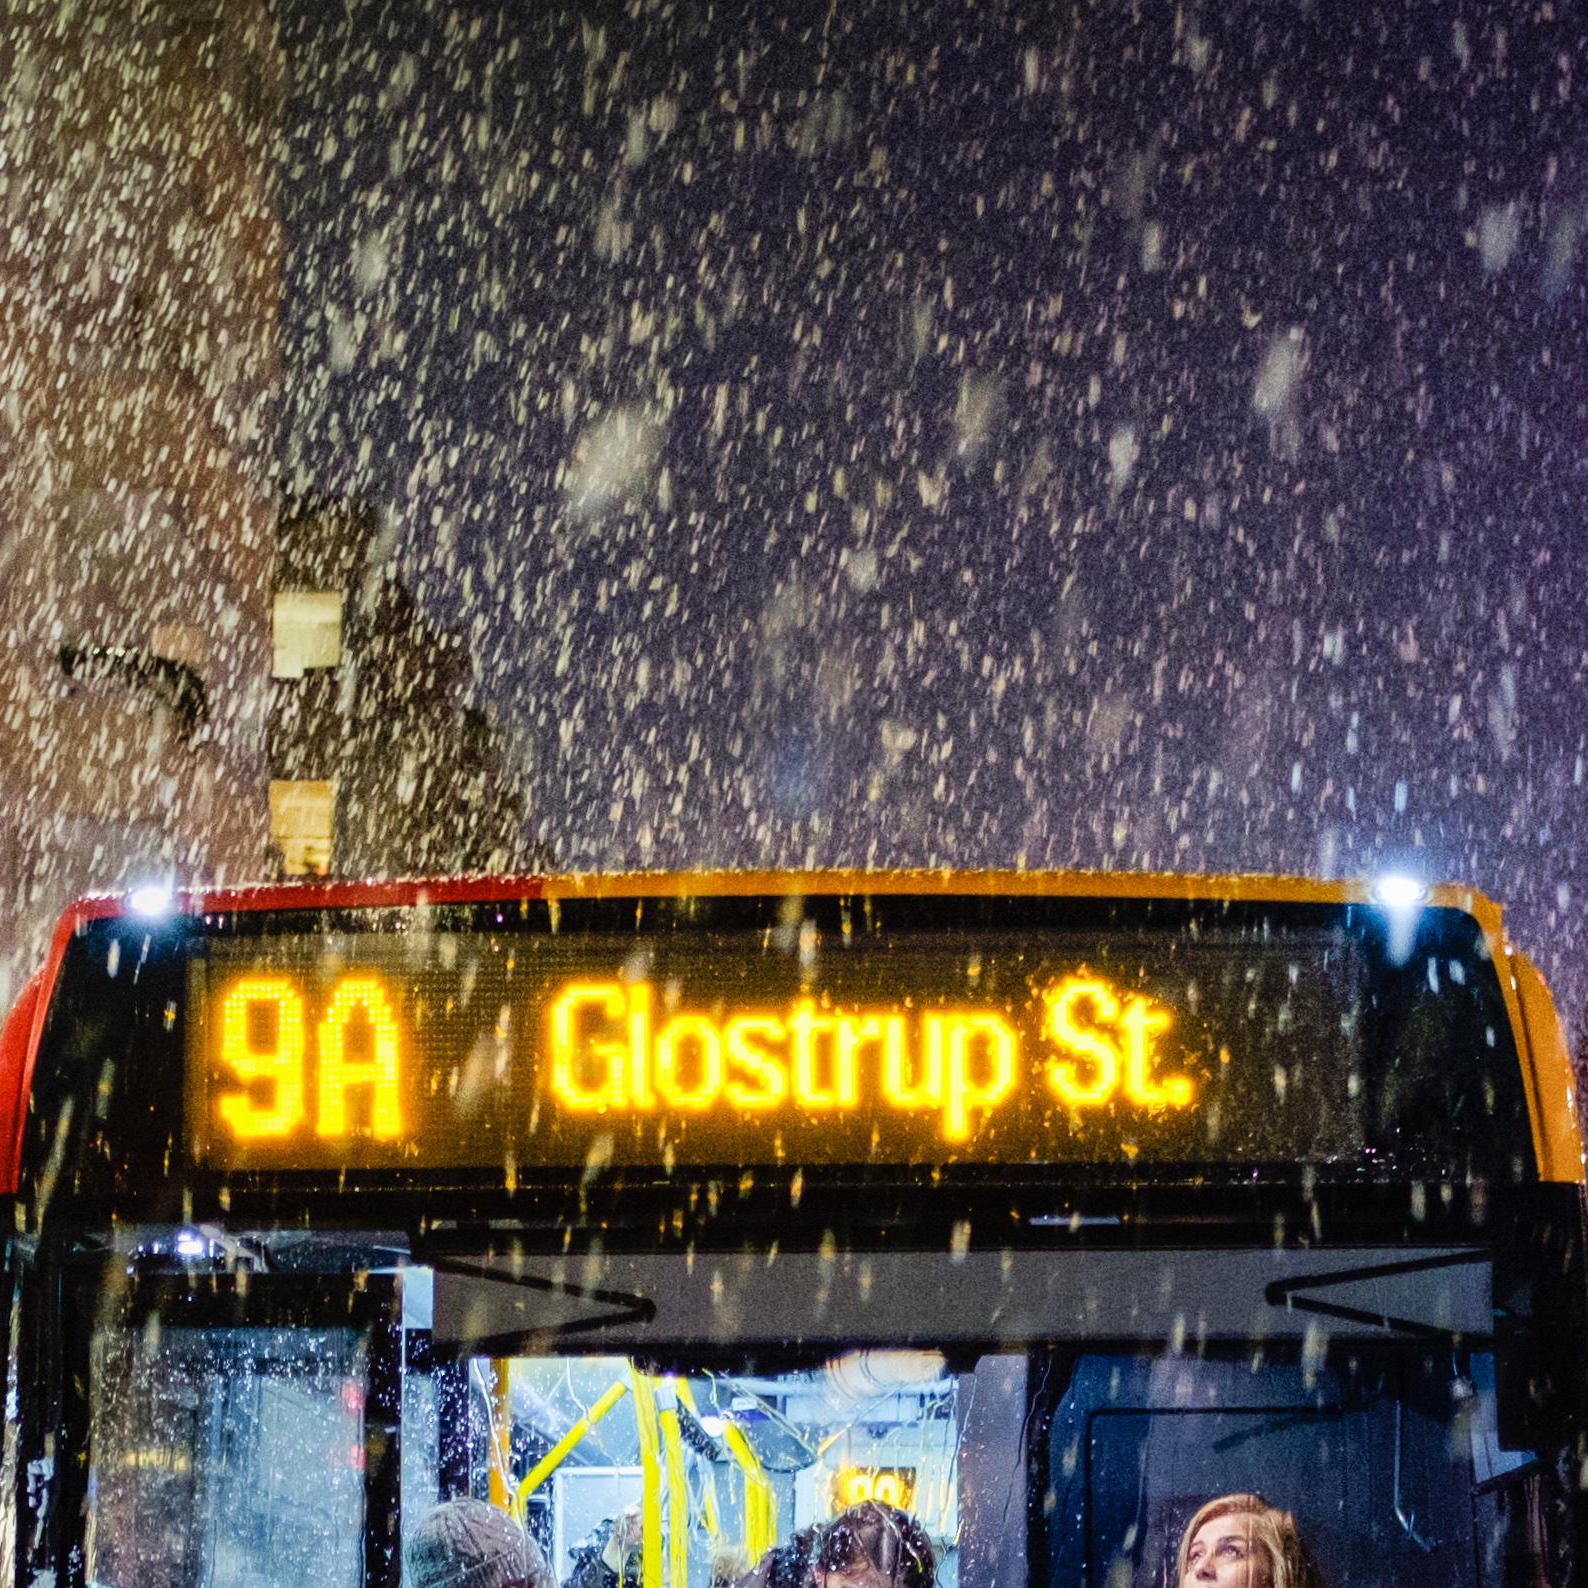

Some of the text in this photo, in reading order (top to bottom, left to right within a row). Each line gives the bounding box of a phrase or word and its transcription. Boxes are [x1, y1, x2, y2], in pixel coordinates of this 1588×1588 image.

[221, 976, 1195, 1141] 9A Glostrup St.
